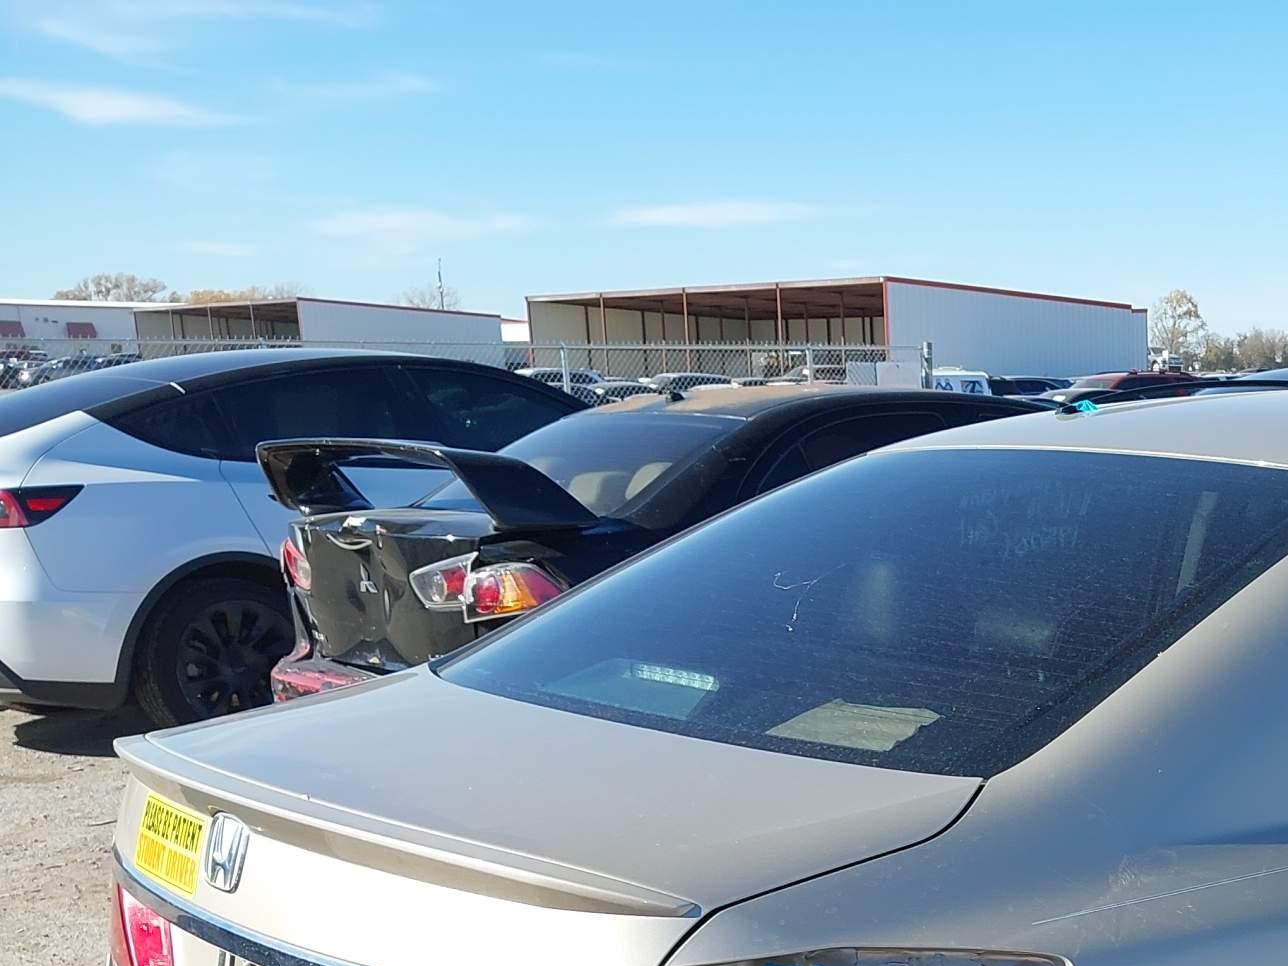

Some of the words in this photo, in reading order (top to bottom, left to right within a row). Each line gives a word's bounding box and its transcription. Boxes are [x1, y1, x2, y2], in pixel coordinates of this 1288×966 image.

[142, 799, 165, 836] PLEASE
[169, 814, 203, 854] PATIENT
[137, 831, 167, 874] STUDENT
[164, 847, 197, 890] DRIVER
